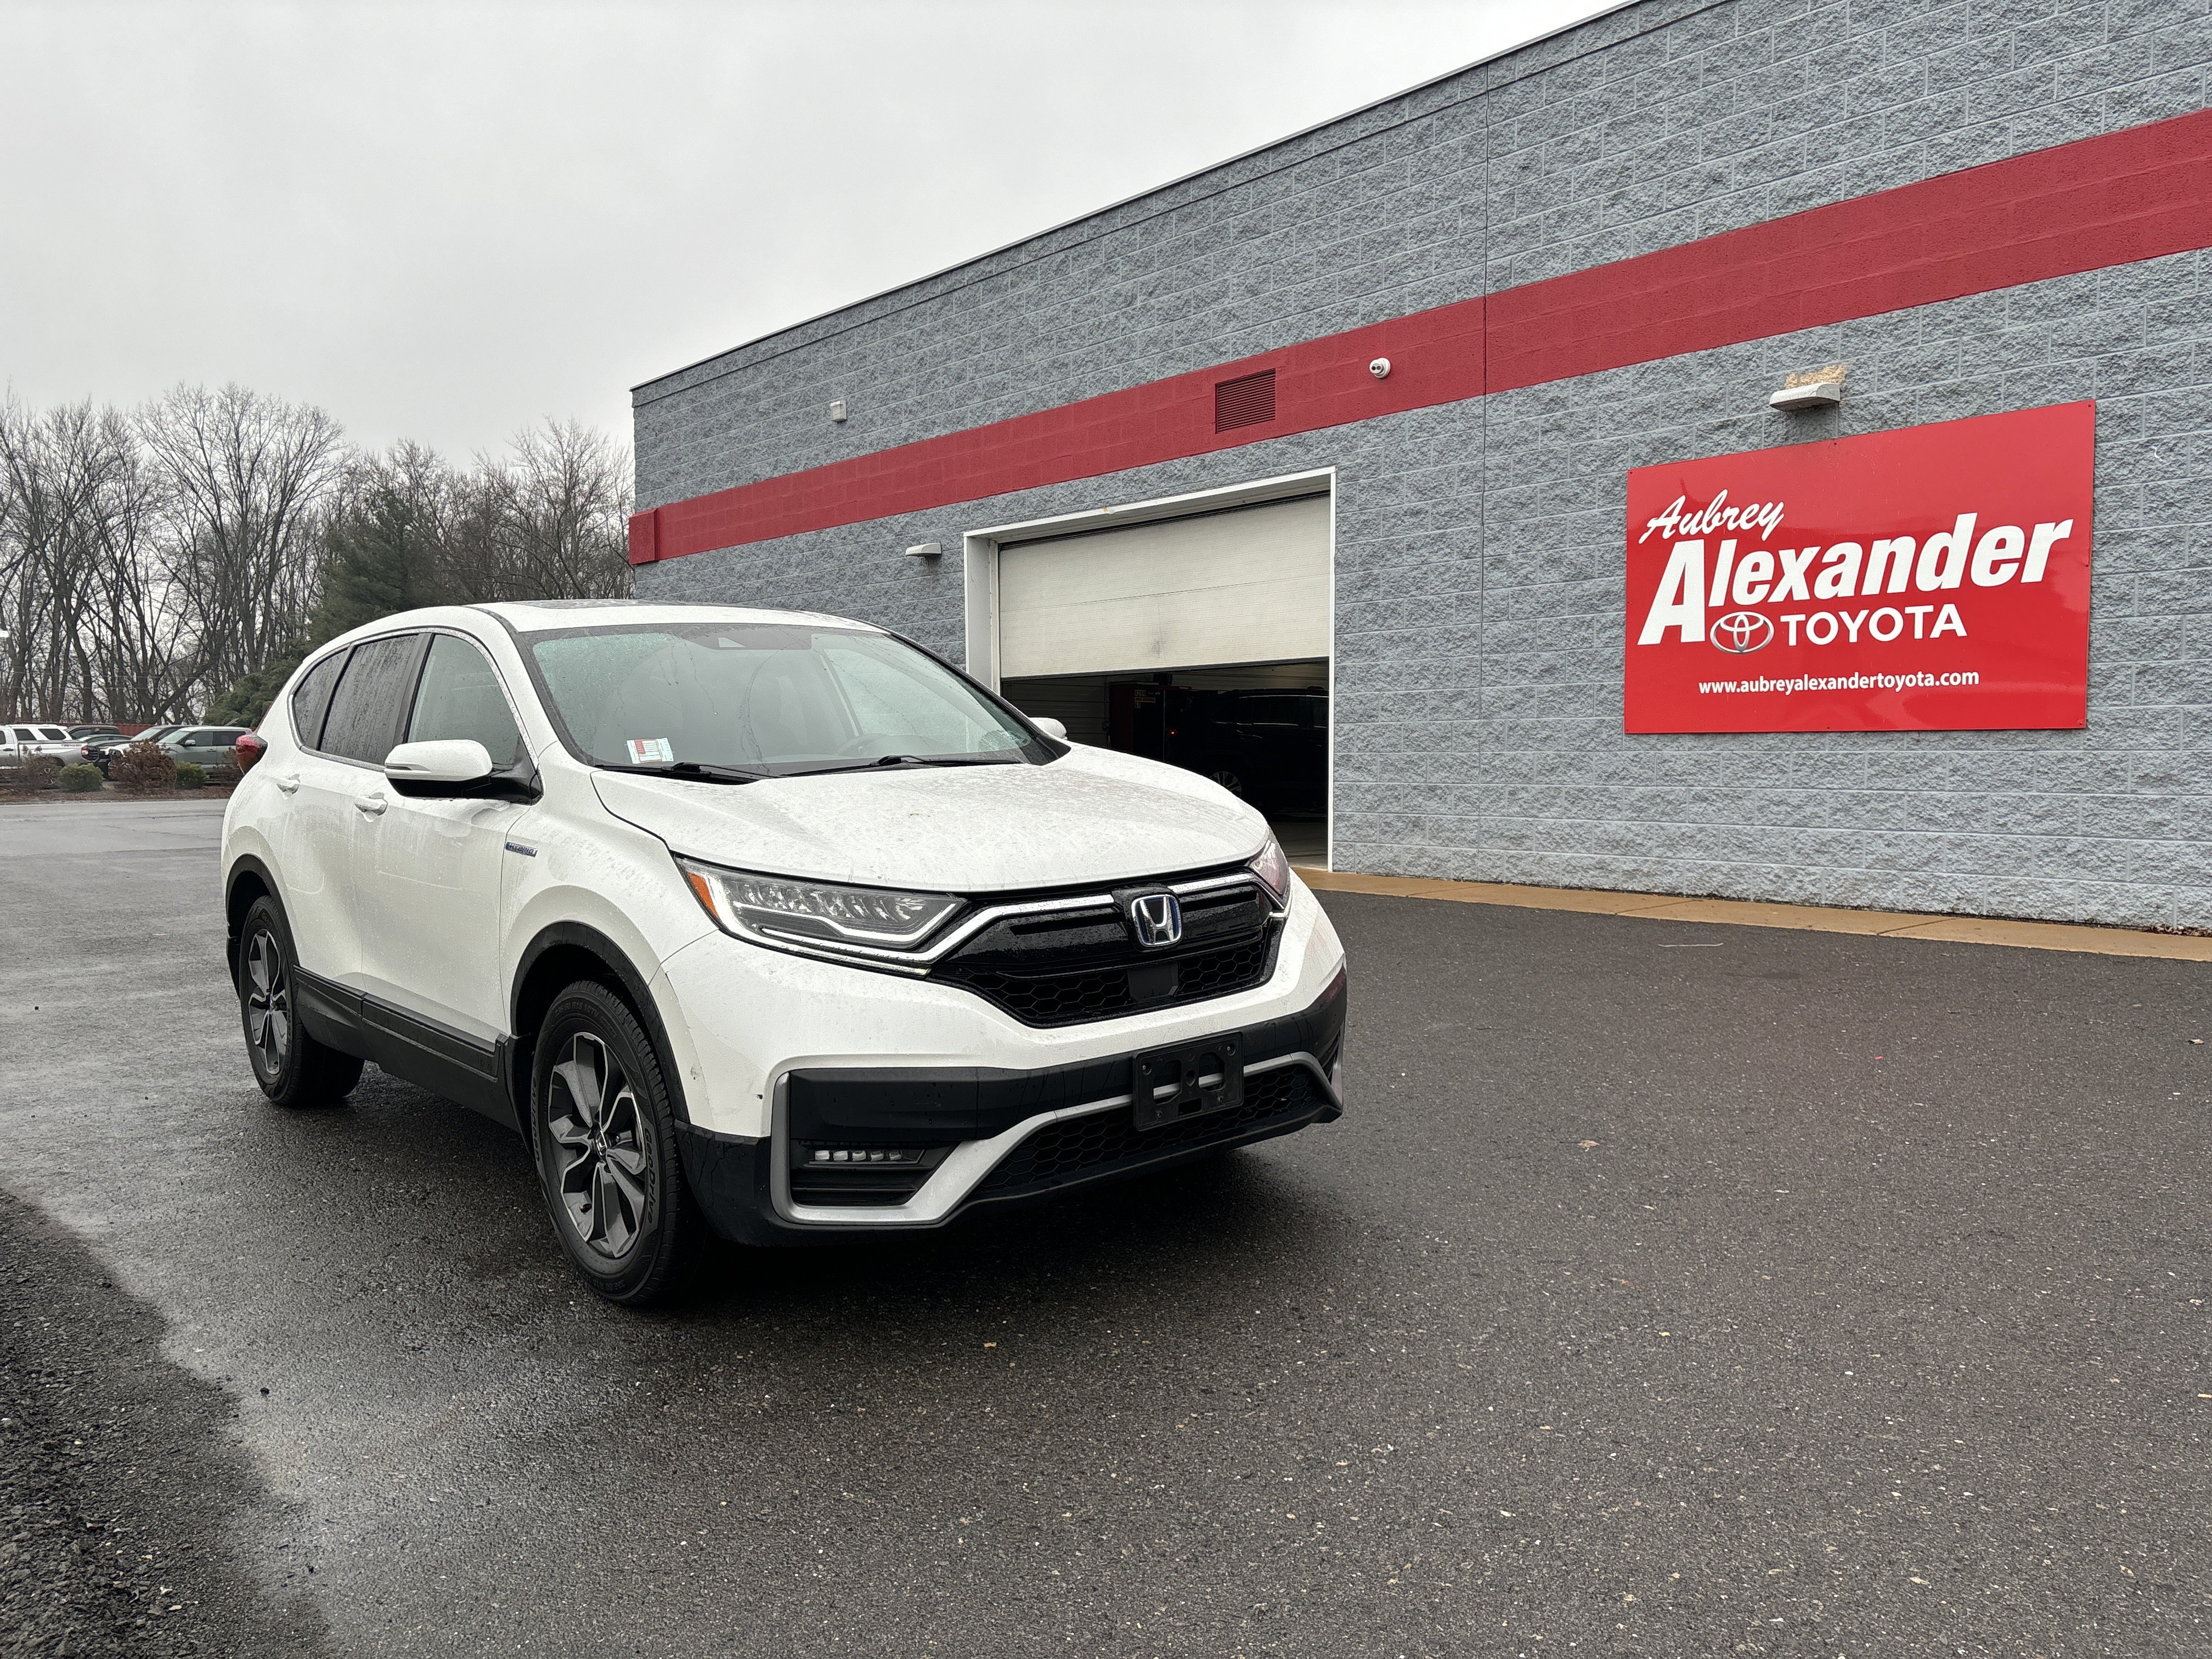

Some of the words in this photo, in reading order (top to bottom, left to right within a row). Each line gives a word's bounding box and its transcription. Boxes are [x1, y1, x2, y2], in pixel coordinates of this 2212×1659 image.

[1638, 489, 1784, 544] Aubrey
[1637, 512, 2074, 645] Alexander
[1780, 603, 1967, 646] TOYOTA
[1699, 671, 1979, 695] www.aubreyalexandertoyota.com
[644, 1127, 656, 1225] GeoDrive
